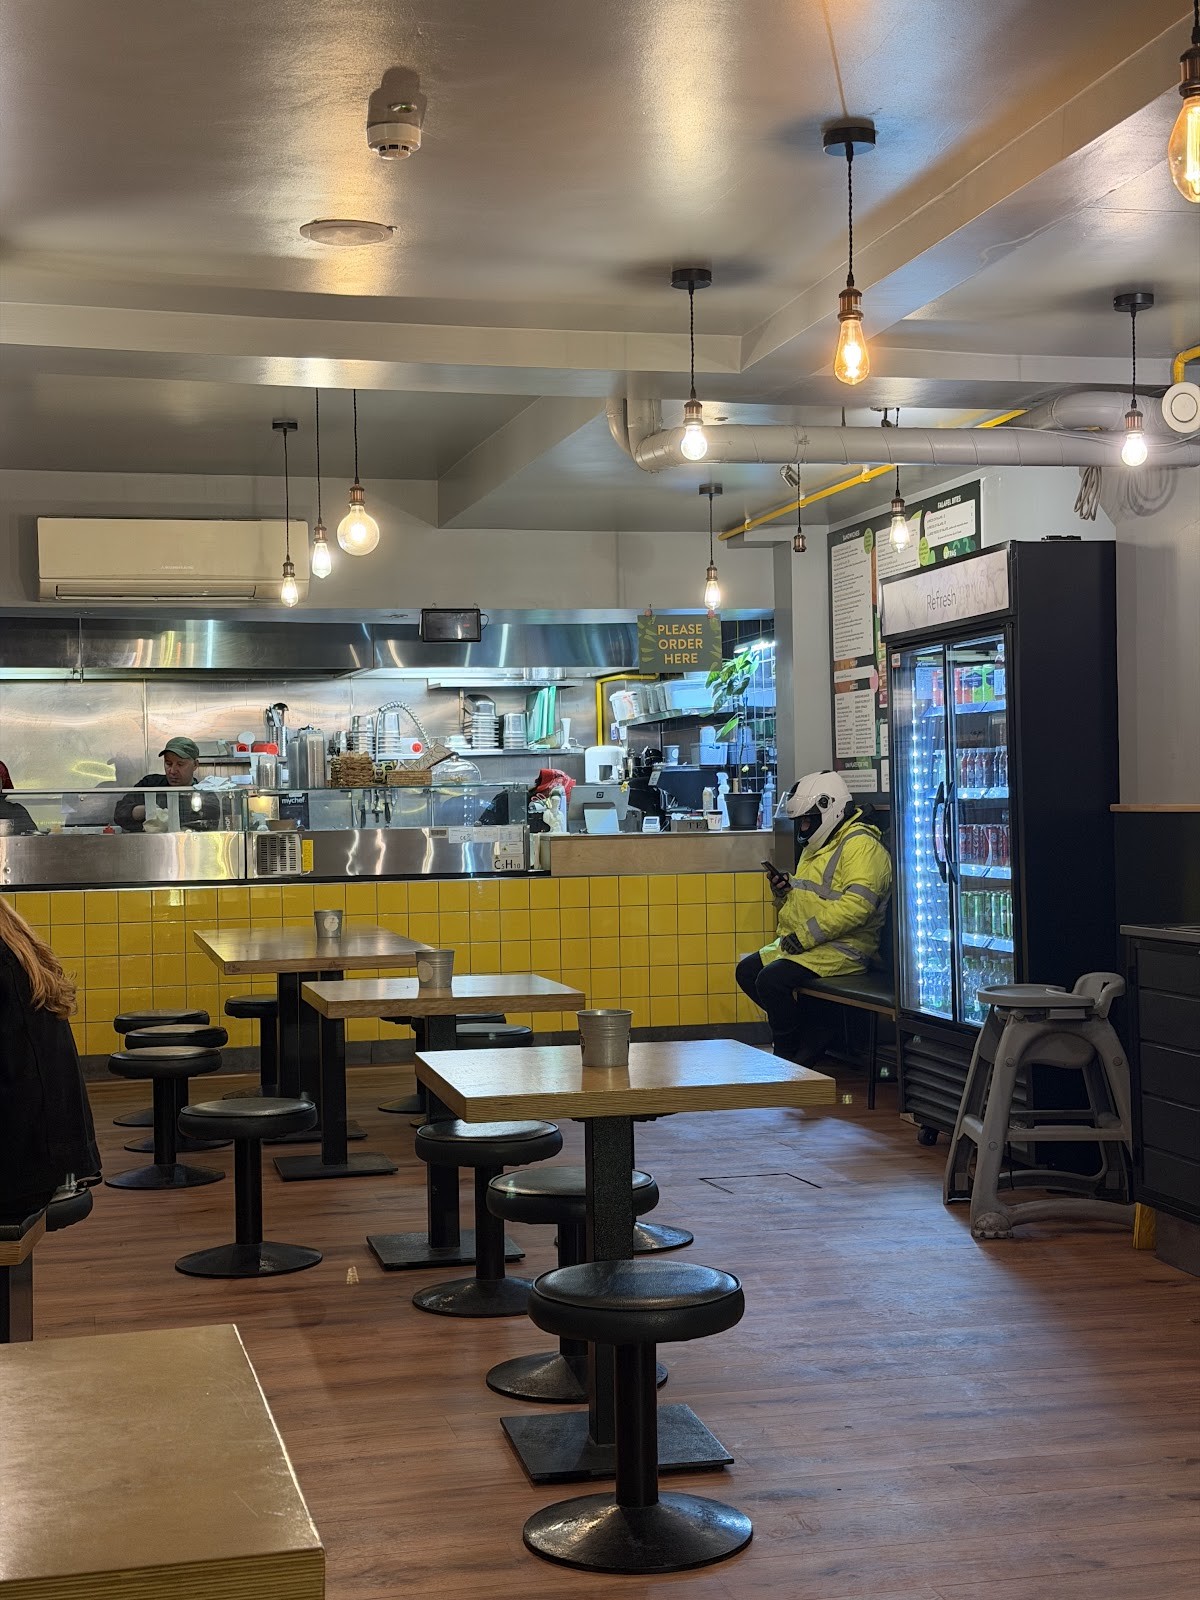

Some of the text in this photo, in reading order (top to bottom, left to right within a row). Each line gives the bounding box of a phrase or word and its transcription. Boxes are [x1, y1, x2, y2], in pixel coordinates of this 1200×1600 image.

[926, 588, 957, 610] Refresh
[656, 623, 703, 636] PLEASE
[658, 638, 703, 650] ORDER
[664, 652, 698, 665] HERE
